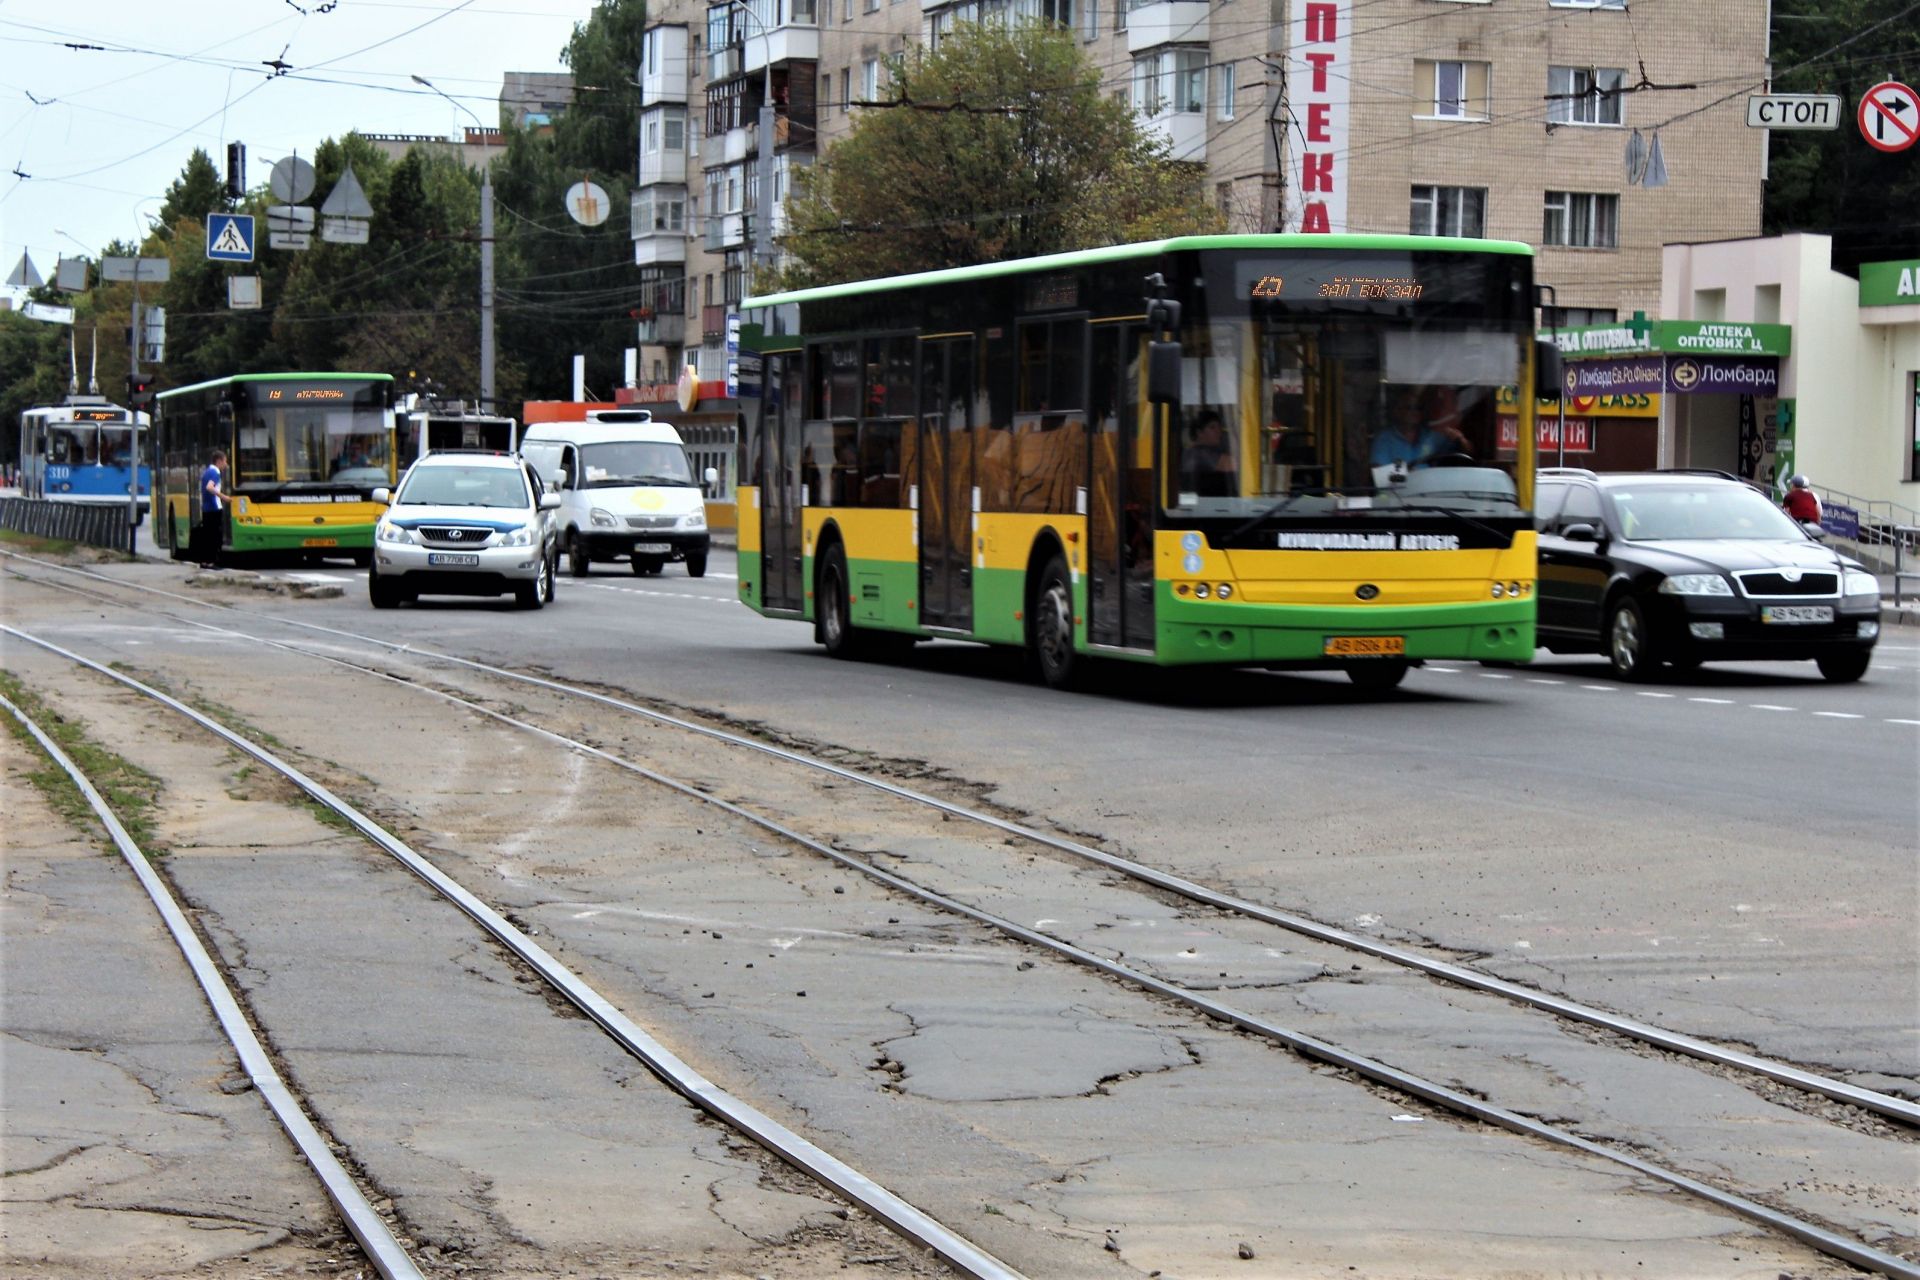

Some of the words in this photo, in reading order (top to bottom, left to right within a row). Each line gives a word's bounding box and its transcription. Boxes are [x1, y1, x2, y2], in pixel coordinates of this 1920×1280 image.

[1759, 102, 1829, 123] СТОП
[1897, 267, 1920, 296] А
[1699, 324, 1753, 338] АПТЕКА
[1678, 335, 1744, 349] ОПТОВИХ
[1751, 338, 1763, 351] Ц
[1579, 368, 1612, 388] Ломбард
[1701, 364, 1776, 387] Ломбард
[49, 466, 69, 479] 310
